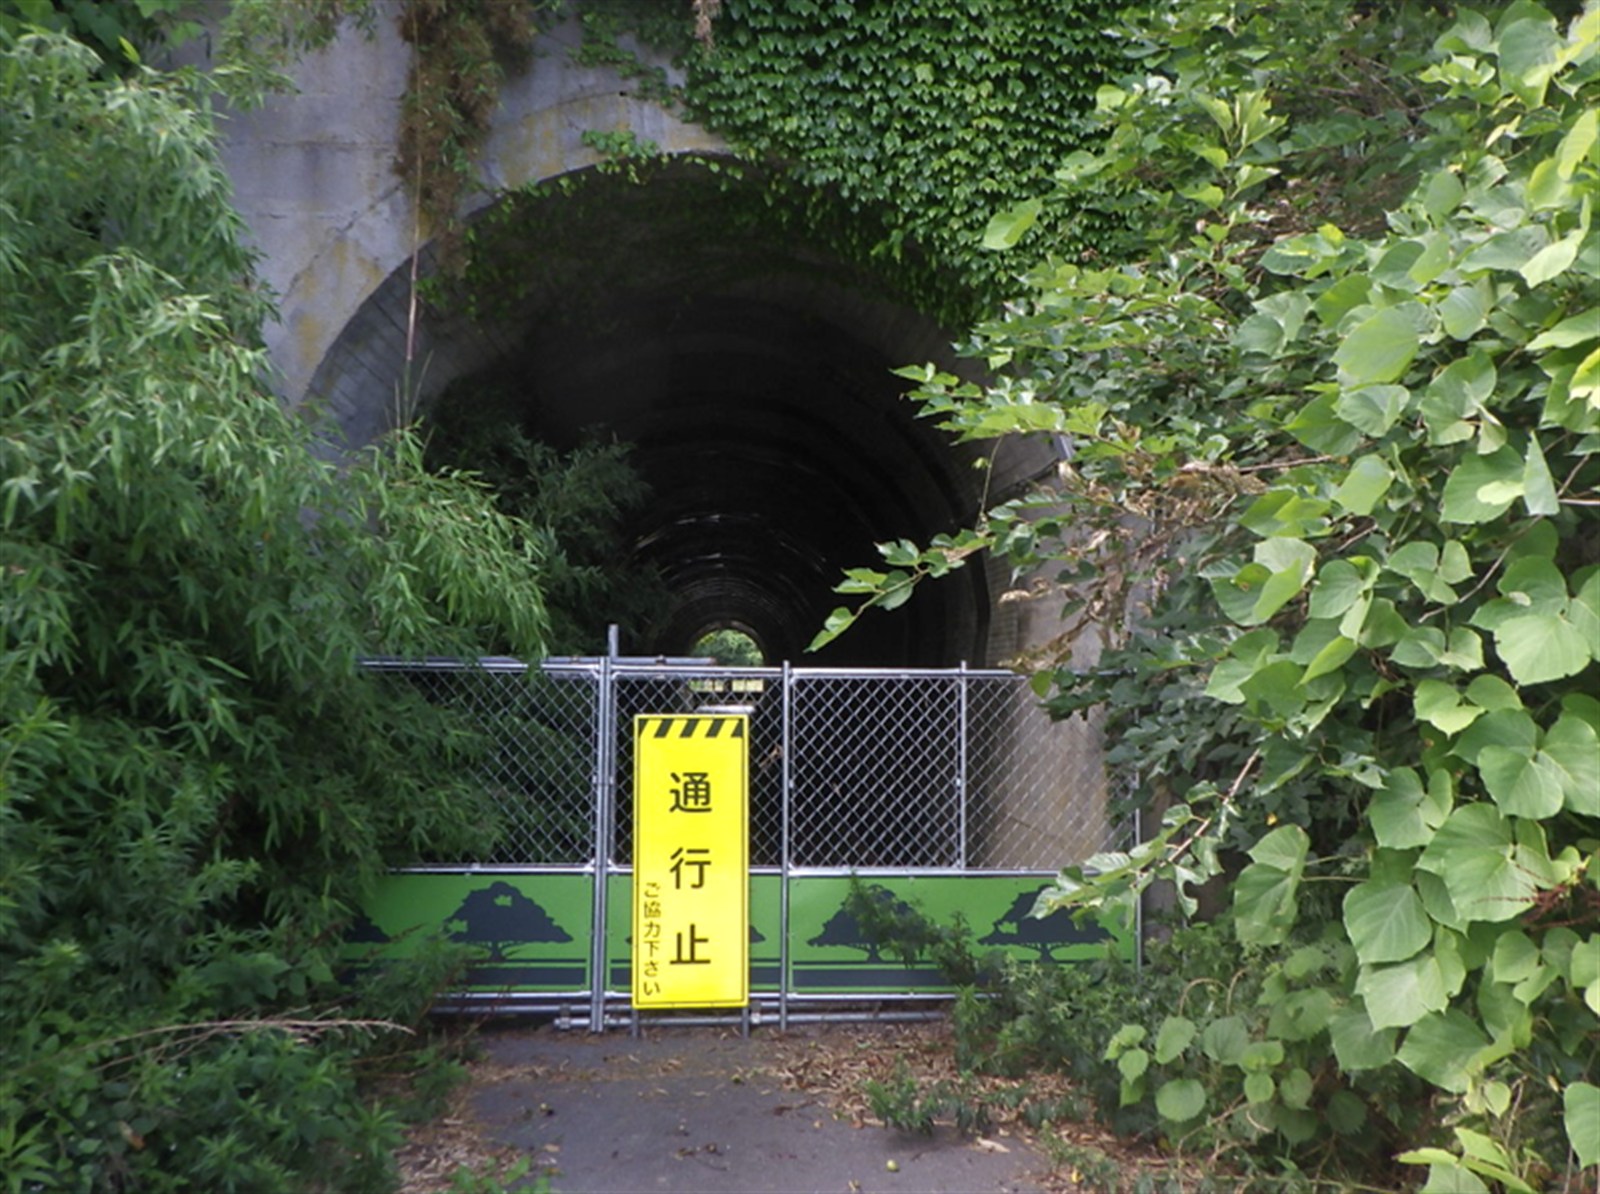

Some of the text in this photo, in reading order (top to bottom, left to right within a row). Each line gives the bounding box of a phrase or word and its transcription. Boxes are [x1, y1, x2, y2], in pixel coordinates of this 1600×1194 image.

[643, 882, 661, 997] ご協力下さい
[669, 772, 712, 965] 通行止
